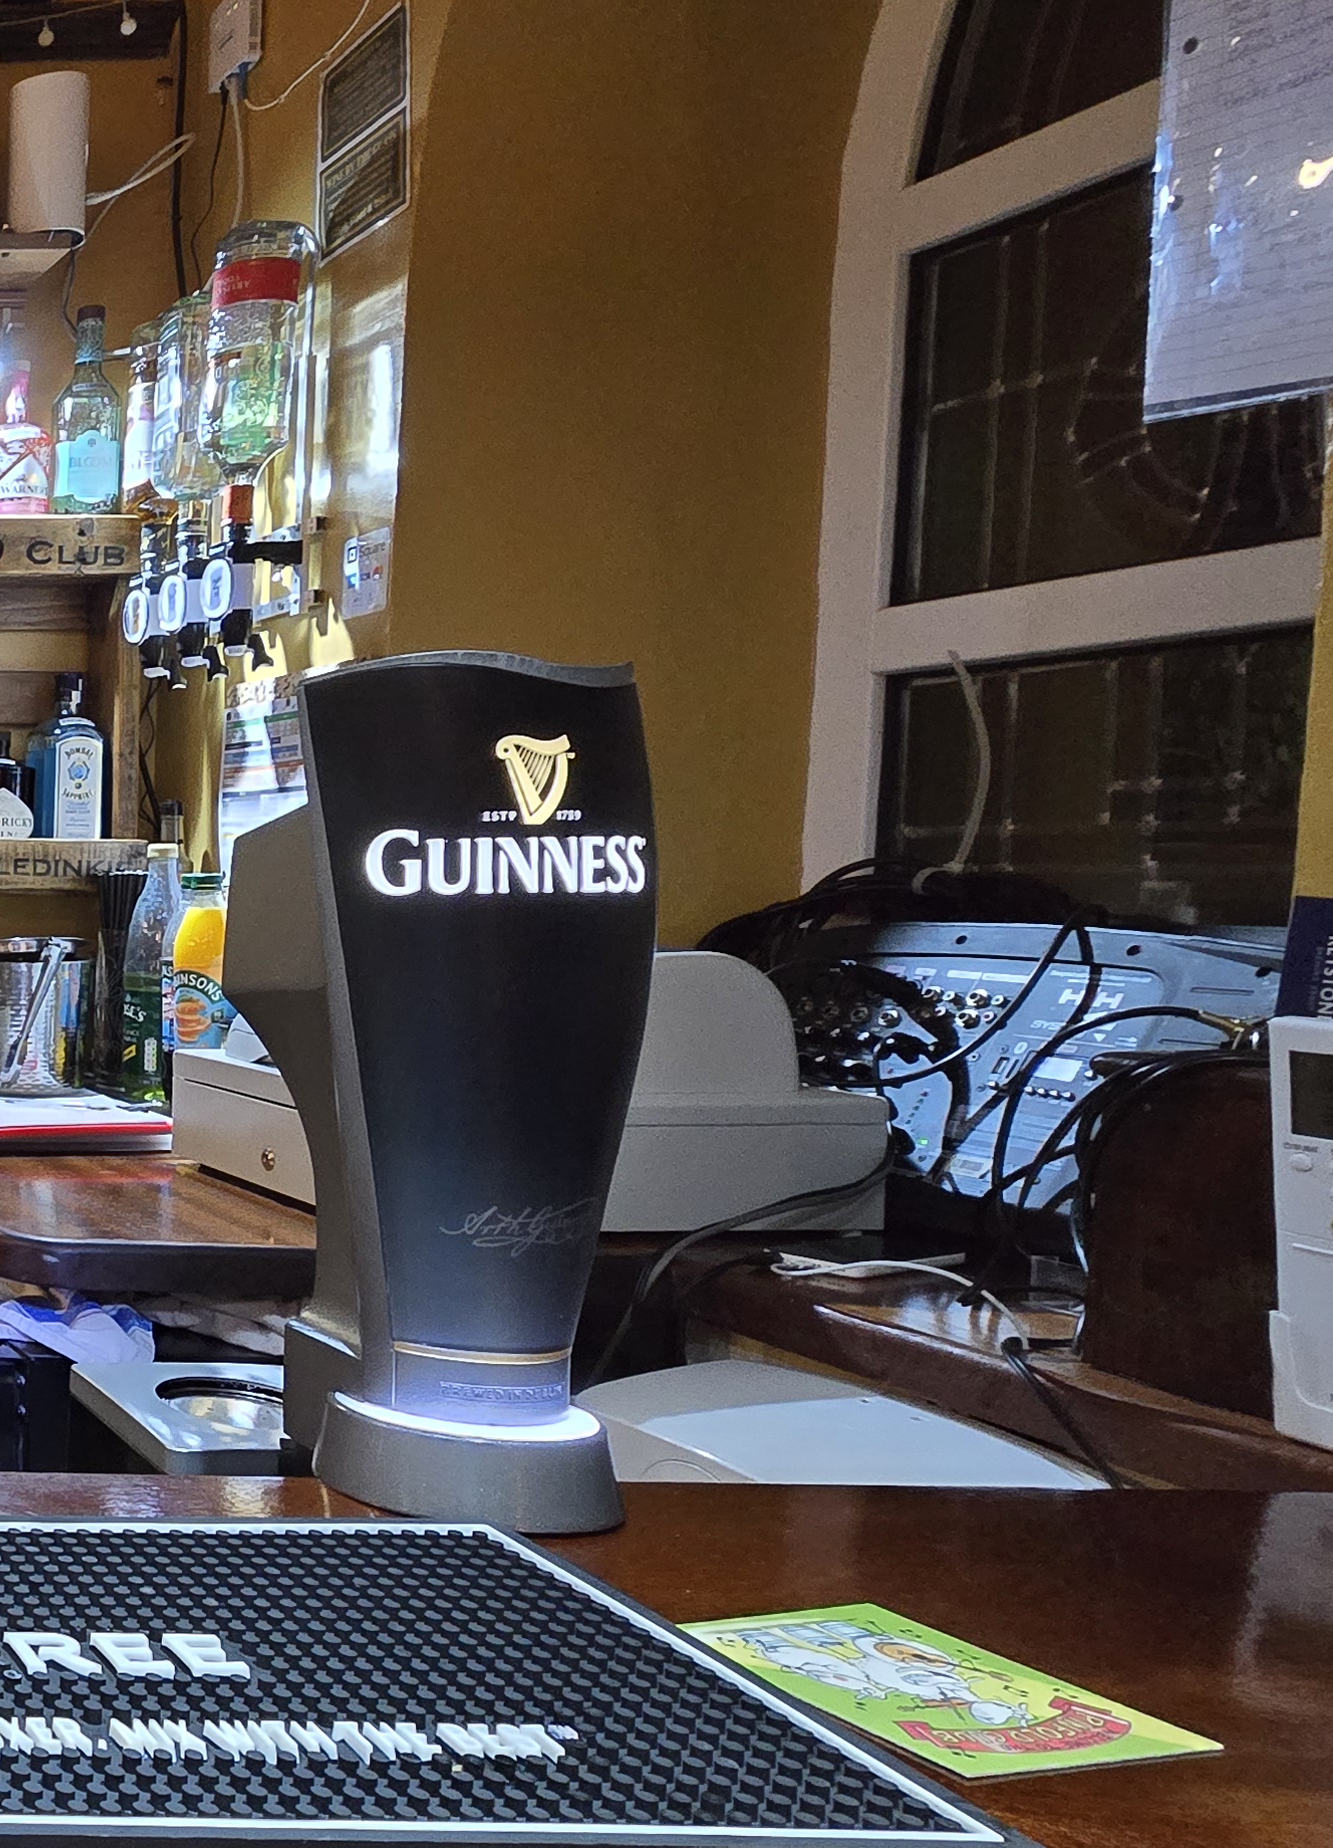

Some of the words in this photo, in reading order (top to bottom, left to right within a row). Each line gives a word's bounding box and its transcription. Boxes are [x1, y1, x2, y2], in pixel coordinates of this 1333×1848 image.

[26, 540, 126, 566] CLUB
[366, 829, 646, 897] GUINNESS
[440, 1381, 504, 1400] BREWED
[109, 1717, 208, 1763] MIX
[201, 1719, 338, 1766] WITH
[331, 1720, 442, 1763] THE
